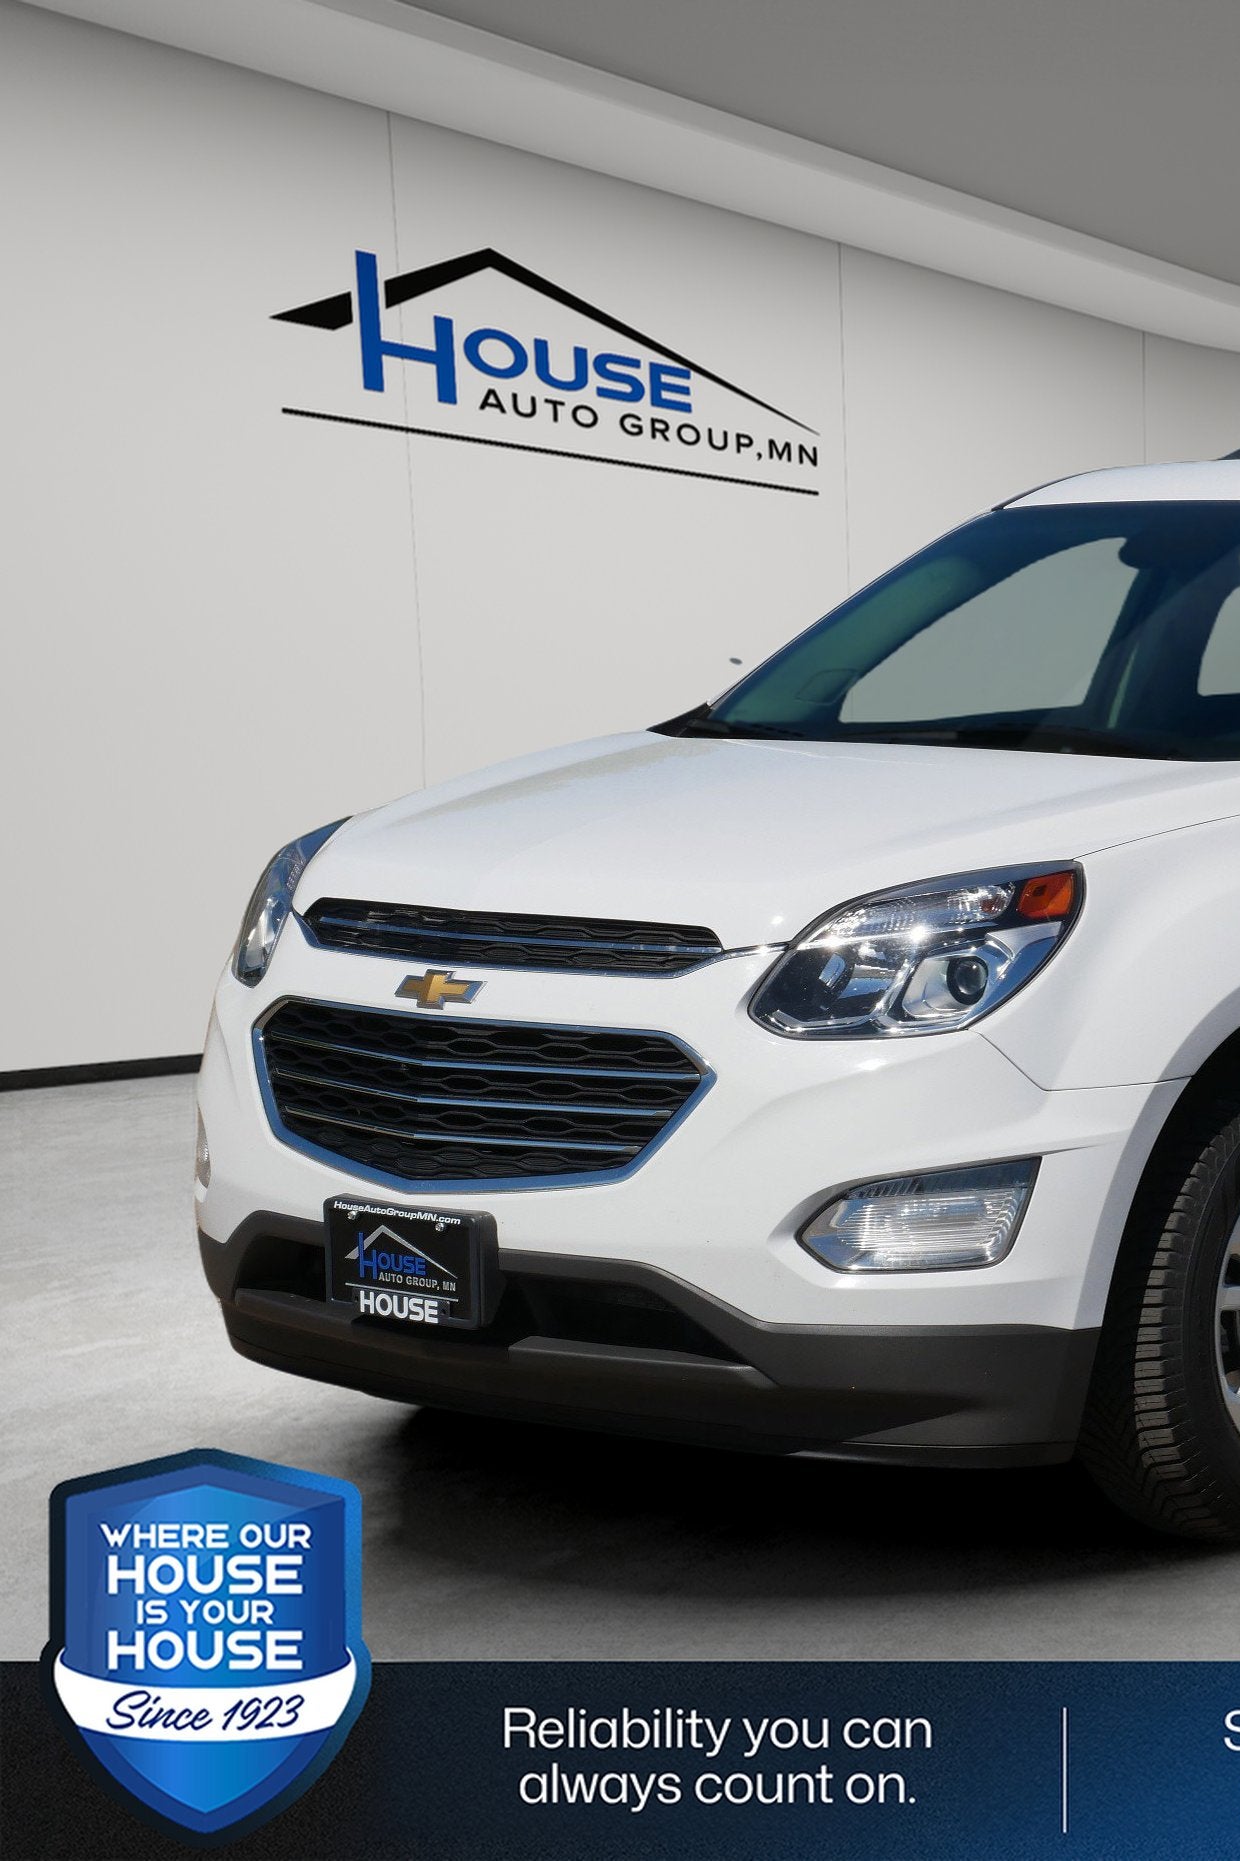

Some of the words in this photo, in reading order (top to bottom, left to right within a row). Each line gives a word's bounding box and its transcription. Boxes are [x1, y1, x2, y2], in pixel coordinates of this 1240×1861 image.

[355, 250, 692, 413] HOUSE
[479, 388, 599, 429] AUTO
[333, 1201, 461, 1225] HouseAutoGroupMN.com
[358, 1232, 426, 1280] HOUSE
[378, 1272, 403, 1284] AUTO
[405, 1276, 440, 1291] GROUP,
[443, 1281, 456, 1292] MN
[359, 1290, 439, 1323] HOUSE
